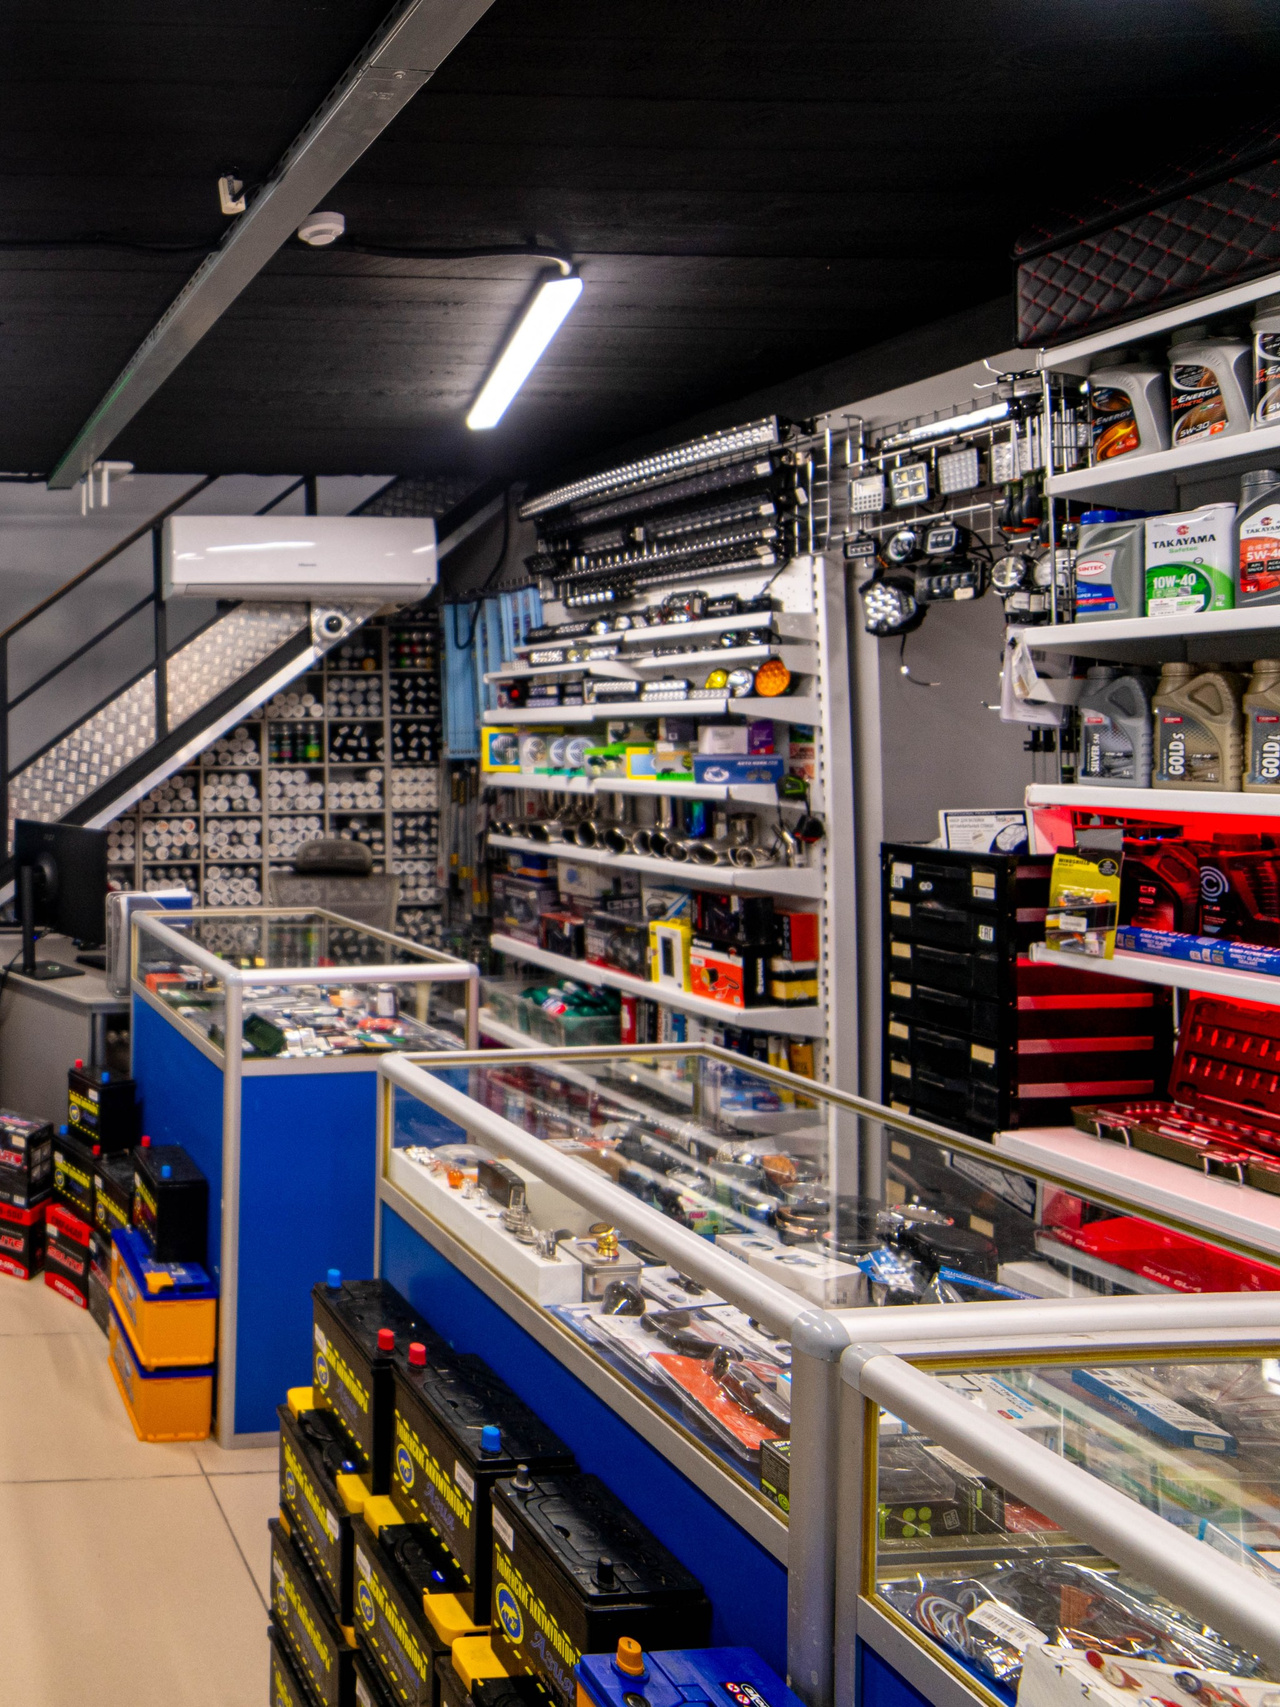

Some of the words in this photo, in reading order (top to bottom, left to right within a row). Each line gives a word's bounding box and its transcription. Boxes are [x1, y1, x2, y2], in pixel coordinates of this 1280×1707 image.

[1179, 420, 1210, 438] 5W-30
[1152, 534, 1216, 550] TAKAYAMA
[1245, 525, 1280, 535] TAKAYAM
[1077, 564, 1105, 573] SINTEC
[1152, 573, 1197, 590] 10W-40
[1090, 745, 1100, 772] SILVER
[1169, 740, 1185, 775] GOLD
[1261, 741, 1280, 778] GOLD
[47, 1245, 84, 1276] SOLITE
[1143, 1265, 1170, 1282] GEAR
[1174, 1279, 1202, 1293] GL-4
[396, 1419, 426, 1471] ТЮМЕНСКИЕ
[425, 1457, 470, 1530] АККУМУЛЯТОРЫ
[496, 1551, 530, 1611] ТЮМЕНСКИЕ
